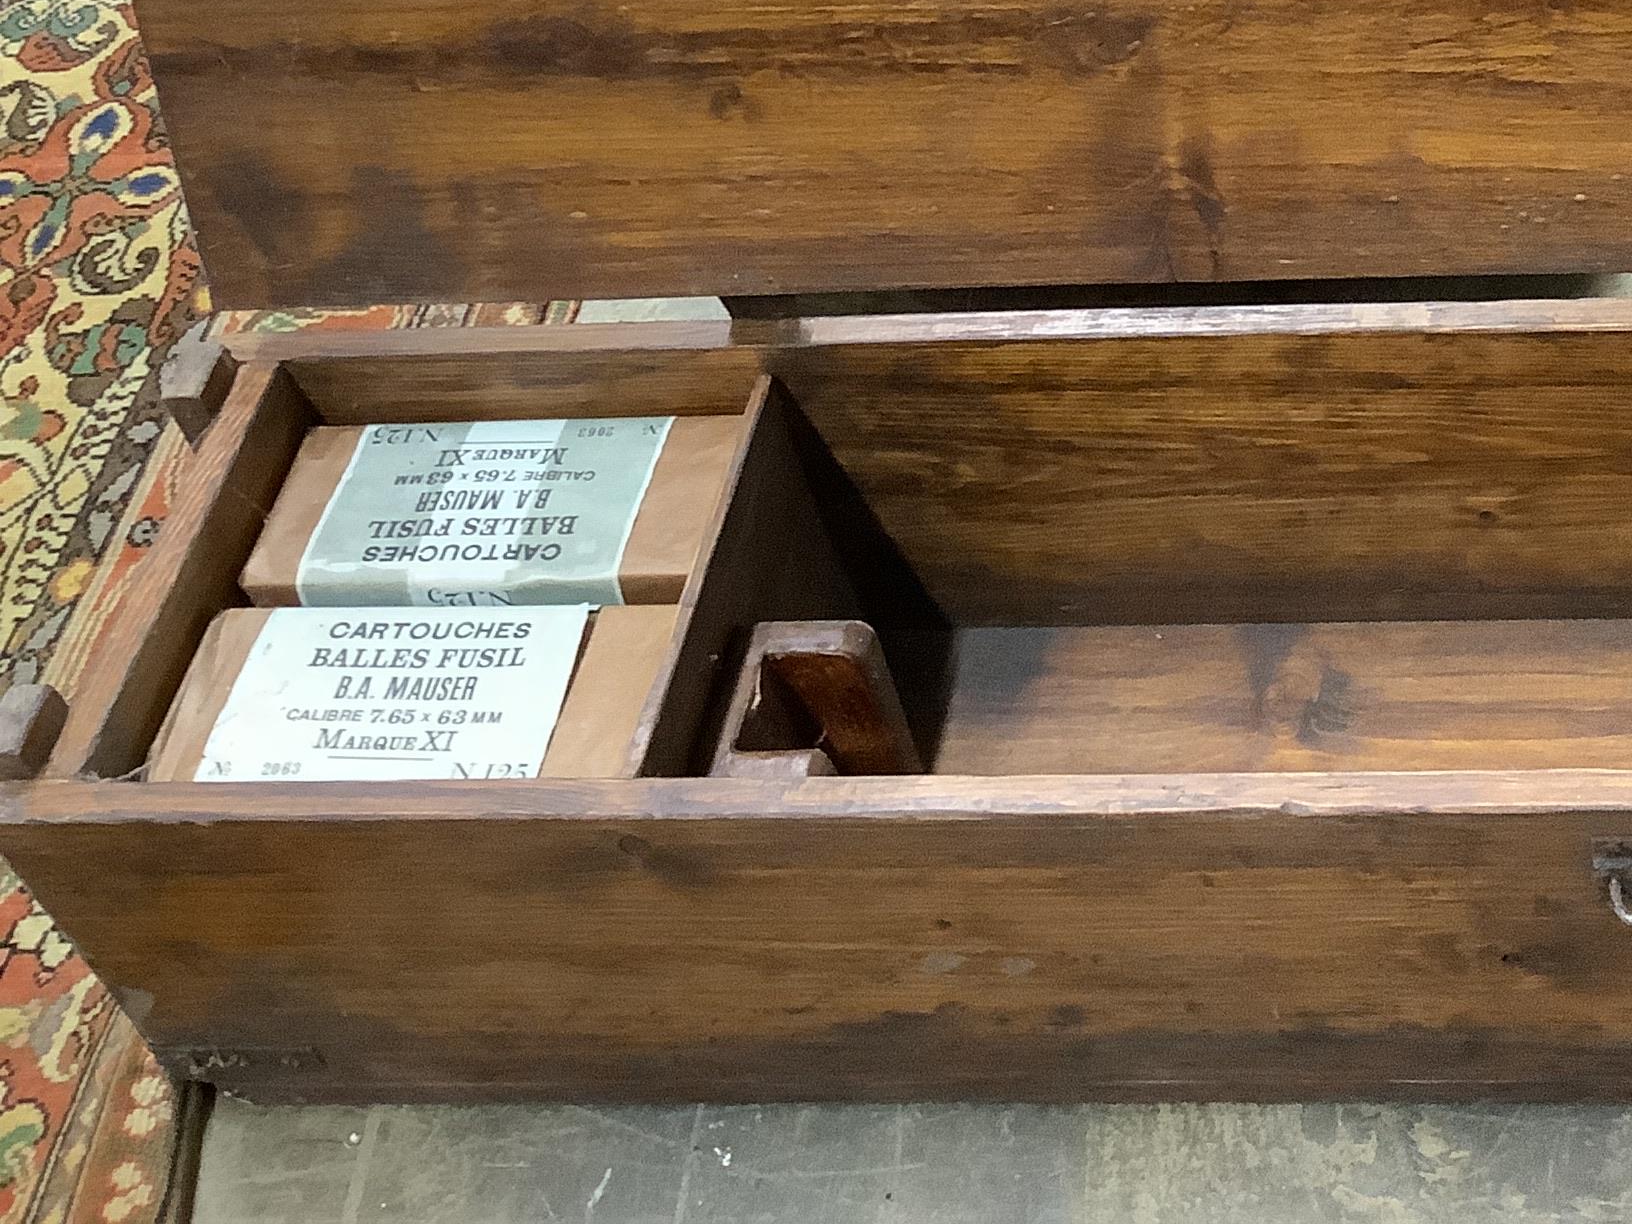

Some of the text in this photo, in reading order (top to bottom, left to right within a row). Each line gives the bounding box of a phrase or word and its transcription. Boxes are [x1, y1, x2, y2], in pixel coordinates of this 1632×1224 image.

[435, 450, 469, 467] XI
[428, 471, 454, 485] 63
[474, 470, 516, 483] 7.65
[523, 470, 596, 482] CALIBRE
[415, 489, 552, 512] B.A. MAUSER
[368, 515, 578, 538] BALLES FUSIL
[362, 544, 562, 562] CARTOUCHES
[329, 622, 532, 639] CARTOUCHES
[308, 648, 527, 668] BALLES FUSIL
[334, 676, 478, 700] B.A. MAUSER
[286, 708, 362, 722] CALIBRE
[369, 709, 415, 724] 7.65
[437, 710, 467, 724] 63
[418, 731, 458, 752] XI
